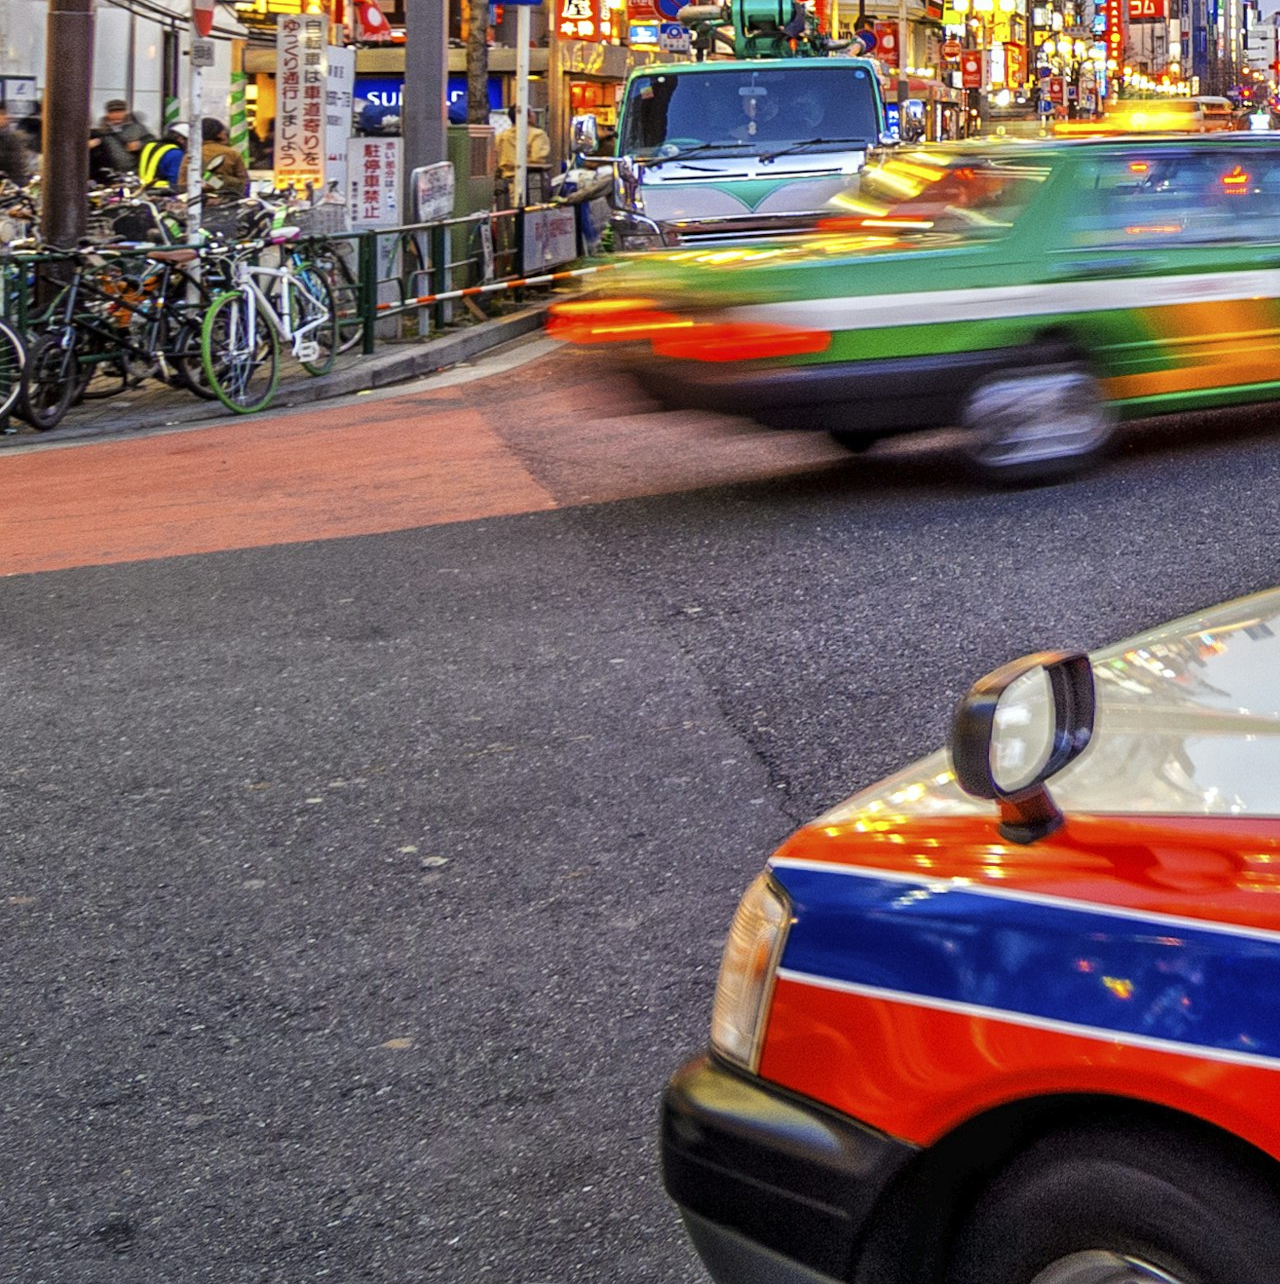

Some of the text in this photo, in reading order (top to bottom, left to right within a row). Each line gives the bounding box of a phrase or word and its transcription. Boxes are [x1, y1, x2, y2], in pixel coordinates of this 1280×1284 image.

[280, 19, 300, 167] ゆっくり通行しましょう
[303, 19, 322, 166] 自転車は車道寄りを
[363, 143, 381, 220] 駐停車禁止
